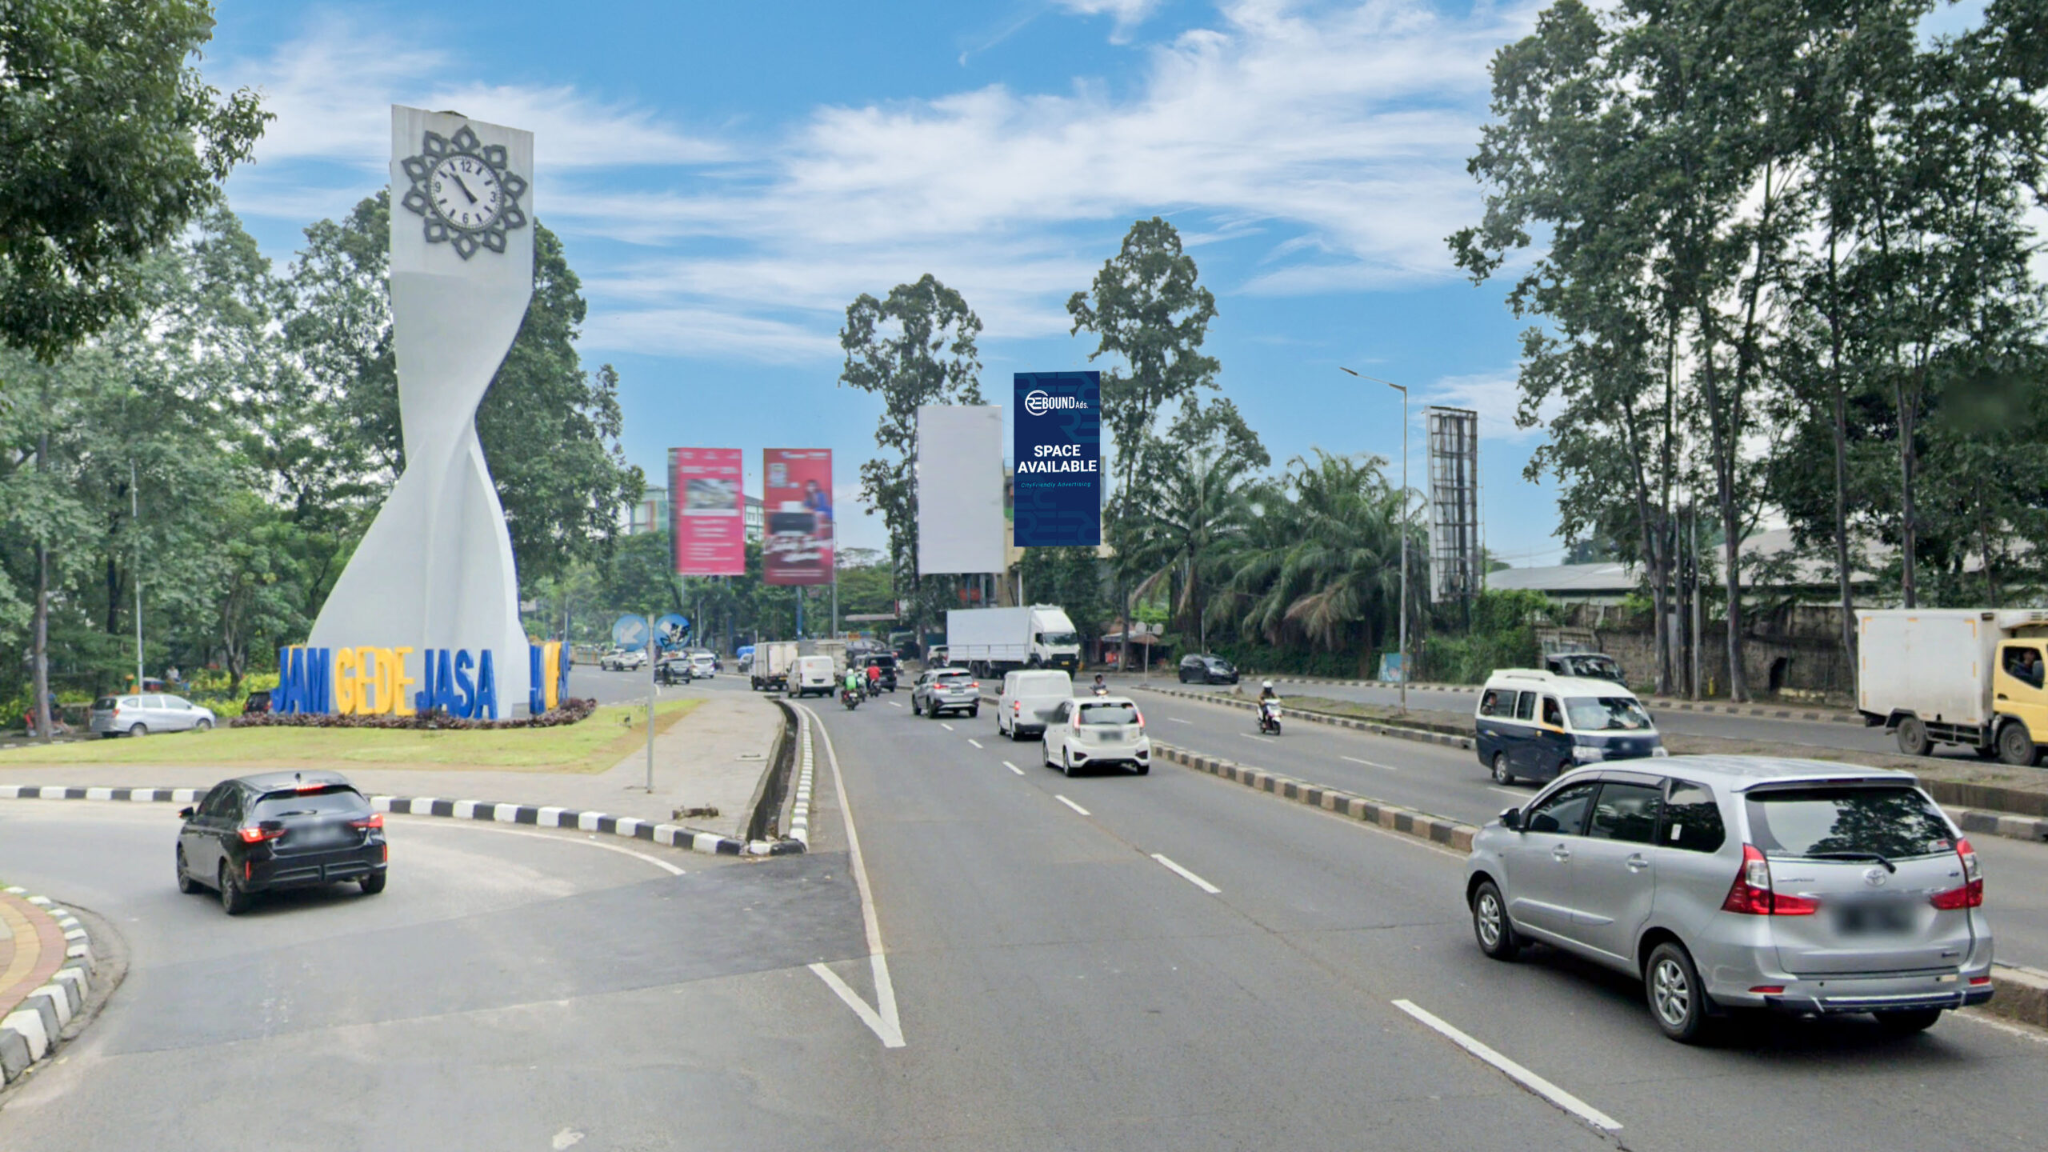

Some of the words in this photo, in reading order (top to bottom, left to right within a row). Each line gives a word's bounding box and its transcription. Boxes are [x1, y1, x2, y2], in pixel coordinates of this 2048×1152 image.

[461, 160, 472, 173] 12
[435, 182, 442, 192] 9
[490, 192, 496, 202] 3
[462, 213, 469, 224] 6
[1025, 394, 1075, 412] REBOUND
[1075, 401, 1088, 409] Ads.
[1034, 444, 1081, 457] SPACE
[1017, 460, 1097, 474] AVAILABLE
[270, 647, 330, 715] JAM
[335, 646, 416, 716] GEDE
[415, 649, 498, 720] JASA
